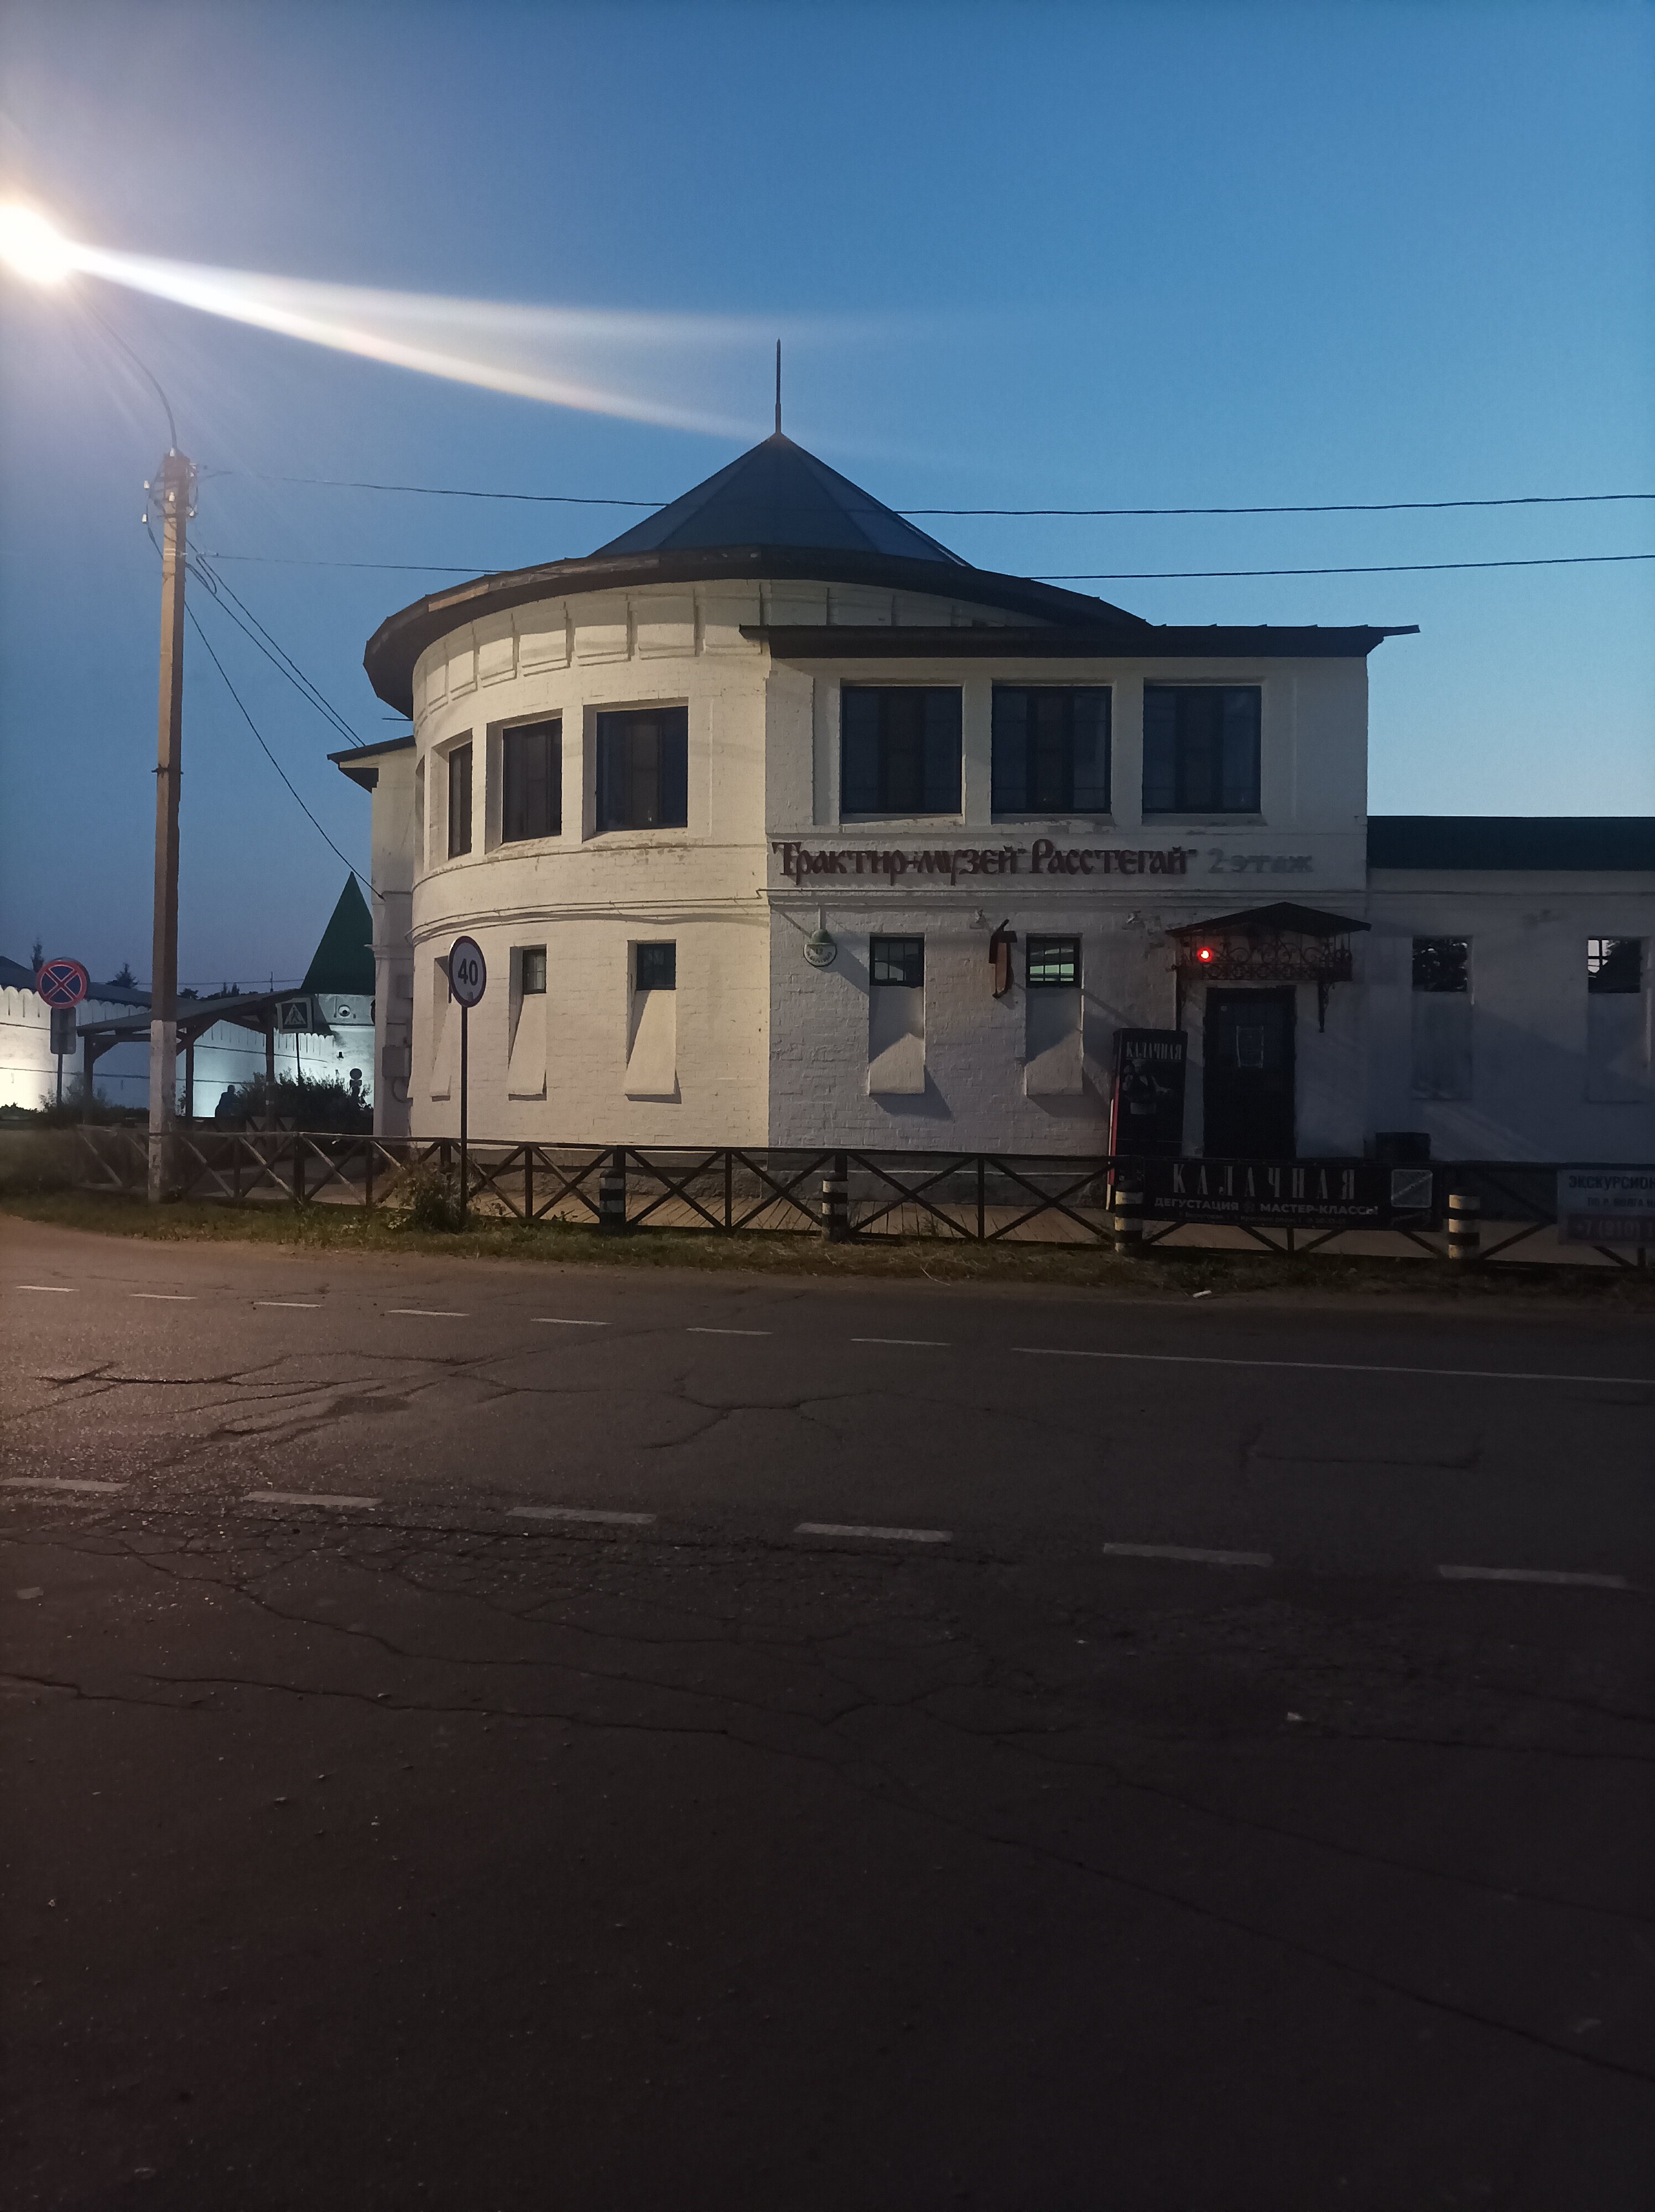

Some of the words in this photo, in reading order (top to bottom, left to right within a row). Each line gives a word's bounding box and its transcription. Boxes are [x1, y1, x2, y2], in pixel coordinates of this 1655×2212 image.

[1207, 848, 1224, 873] 2
[458, 958, 478, 985] 40
[1126, 1041, 1182, 1060] КАЛАЧНАЯ
[1173, 1164, 1355, 1199] КАЛАЧНАЯ
[1154, 1197, 1239, 1211] ДЕГУСТАЦИЯ
